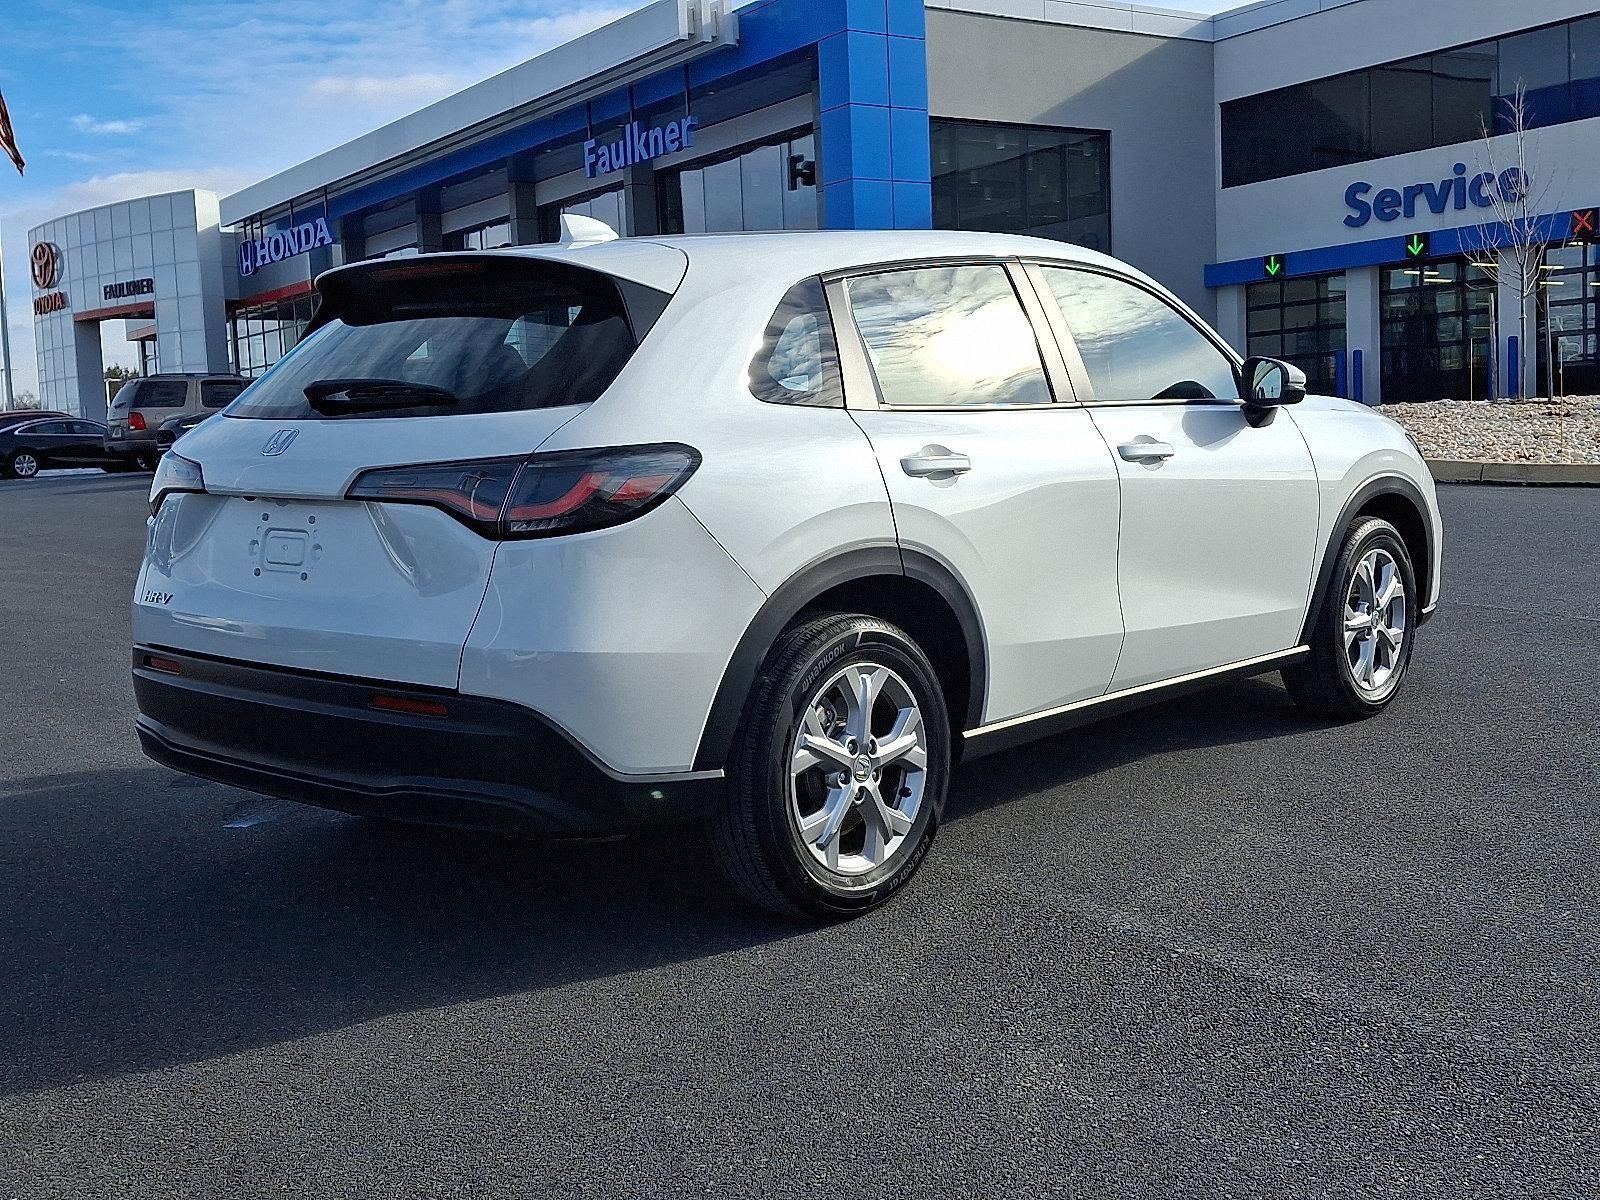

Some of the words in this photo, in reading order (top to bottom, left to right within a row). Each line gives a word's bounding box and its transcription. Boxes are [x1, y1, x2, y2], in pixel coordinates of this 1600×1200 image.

[584, 115, 694, 178] Faulkner
[1342, 162, 1529, 228] Service
[255, 217, 333, 267] HONDA
[33, 291, 65, 315] TOYOTA
[103, 278, 154, 300] FAULKNER
[144, 590, 174, 605] HR-V
